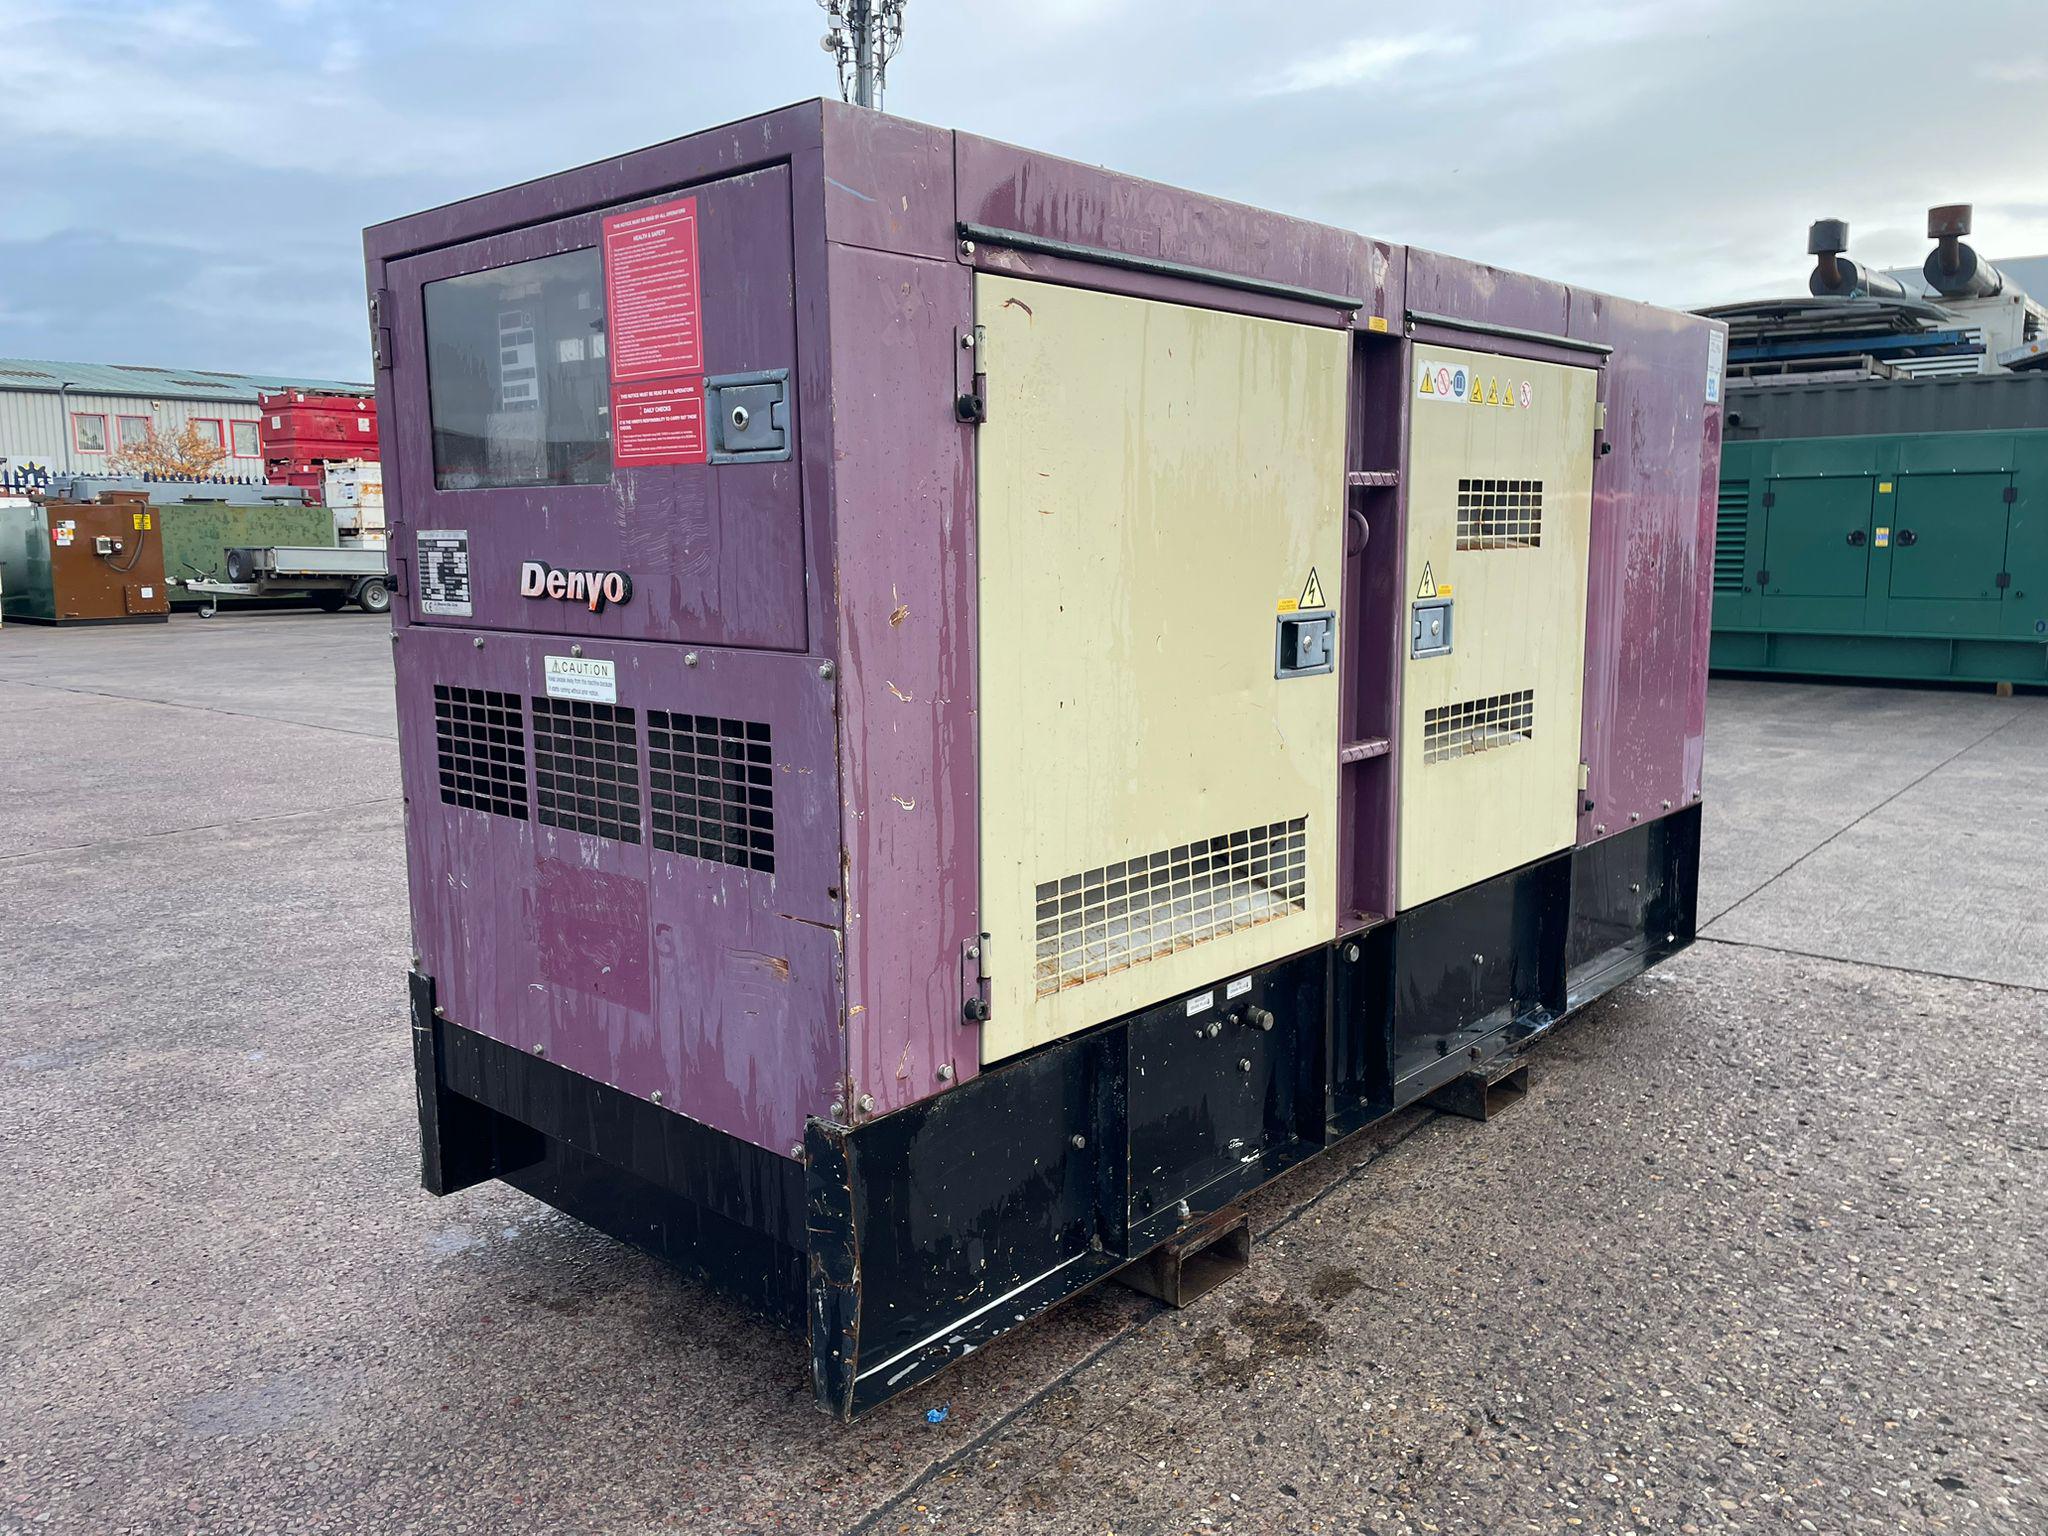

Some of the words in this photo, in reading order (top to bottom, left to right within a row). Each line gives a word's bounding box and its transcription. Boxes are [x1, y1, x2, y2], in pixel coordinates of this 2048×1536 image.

[655, 405, 671, 413] CHECKS
[521, 561, 628, 612] Denyo
[561, 661, 608, 676] CAUTION
